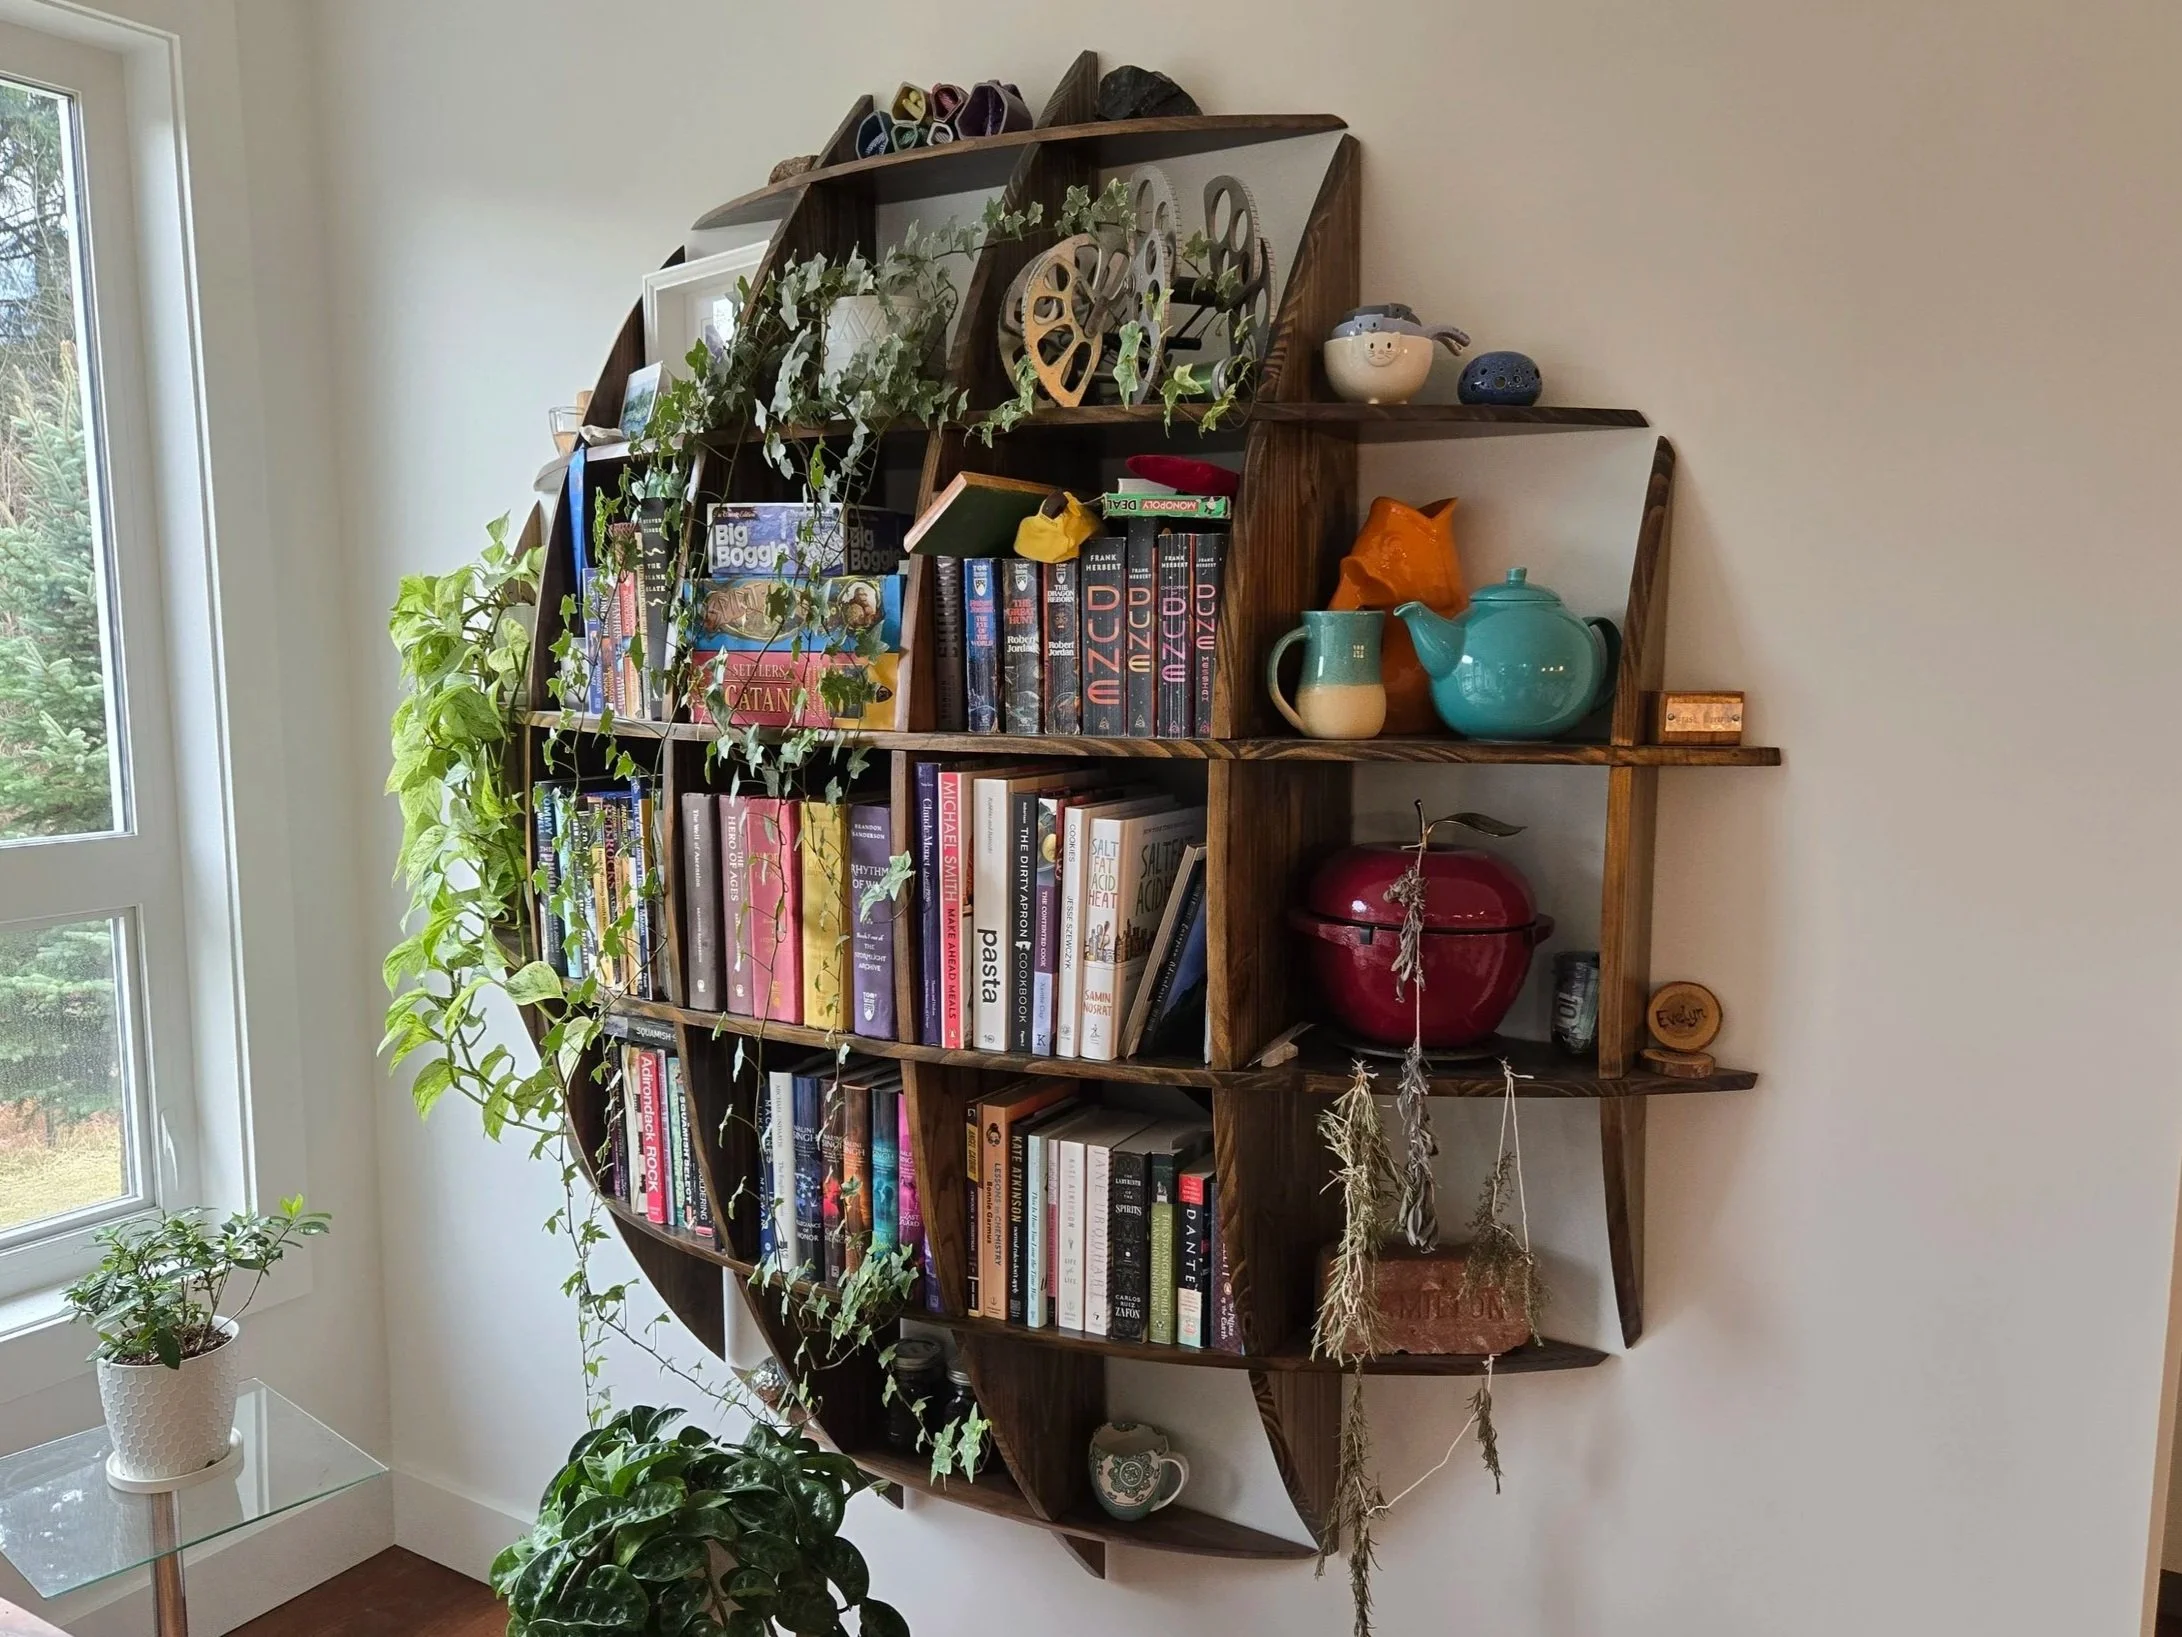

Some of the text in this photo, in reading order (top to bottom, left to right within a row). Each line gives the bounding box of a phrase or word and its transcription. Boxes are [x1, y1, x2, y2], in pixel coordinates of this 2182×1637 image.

[1106, 500, 1197, 510] MONOPOLY DEAL
[716, 524, 748, 548] Big
[850, 527, 874, 550] Big
[718, 542, 790, 569] Boggle
[851, 544, 901, 572] Boggle
[1086, 563, 1121, 571] HERBERT
[1007, 608, 1035, 616] GREAT
[1013, 599, 1032, 607] THE
[1009, 616, 1034, 624] HUNT
[1128, 587, 1151, 673] DUNE
[1196, 584, 1216, 650] DUNE
[1087, 584, 1121, 705] DUNE
[1162, 597, 1187, 683] DUNE
[732, 664, 785, 678] SETTLERS
[724, 685, 791, 713] CATAN
[854, 823, 882, 831] BRANDON
[923, 798, 933, 833] Claude
[851, 831, 885, 840] SANDERSON
[1020, 827, 1029, 851] THE
[1091, 838, 1119, 857] SALT
[605, 835, 616, 889] ROCKS
[728, 816, 739, 901] HERO OF AGES
[923, 835, 933, 867] Monet
[1141, 841, 1171, 879] SALT
[694, 851, 702, 887] Ascension
[851, 864, 889, 876] RHYTHM
[1020, 856, 1029, 891] DIRTY
[1093, 857, 1114, 874] FAT
[853, 879, 864, 888] OF
[1091, 875, 1115, 891] ACID
[943, 781, 958, 1019] MICHAEL SMITH MAKE AHEAD MEALS
[1089, 891, 1118, 909] HEAT
[1136, 878, 1166, 916] ACID
[1019, 895, 1029, 937] APRON
[1040, 906, 1048, 946] CONTENTED
[1064, 896, 1074, 970] JESSE SZEWCZYK
[858, 963, 881, 971] ARCHIVE
[977, 928, 1001, 1004] pasta
[1018, 953, 1028, 1022] COOKBOOK
[1084, 990, 1111, 1003] SAMIN
[1084, 1001, 1112, 1017] NOSRAT
[1656, 1005, 1707, 1028] Evelyn
[636, 1027, 671, 1040] SQUAMISH
[1036, 1033, 1046, 1047] K
[641, 1057, 659, 1193] Adirondack ROCK
[968, 1129, 976, 1147] ANGEL
[1011, 1135, 1023, 1162] KATE
[683, 1159, 692, 1204] SELECT
[1094, 1150, 1106, 1194] JANE
[760, 1177, 768, 1230] McEWAN
[1010, 1167, 1022, 1223] ATKINSON
[1115, 1204, 1142, 1216] SPIRITS
[797, 1232, 819, 1241] HONOR
[1185, 1209, 1197, 1283] DANTE
[1092, 1203, 1105, 1303] URQUHART
[1161, 1214, 1170, 1315] THE STRANGER'S CHILD
[1011, 1278, 1019, 1294] apply
[1115, 1294, 1141, 1302] CARLOS
[1227, 1312, 1235, 1336] Pillars
